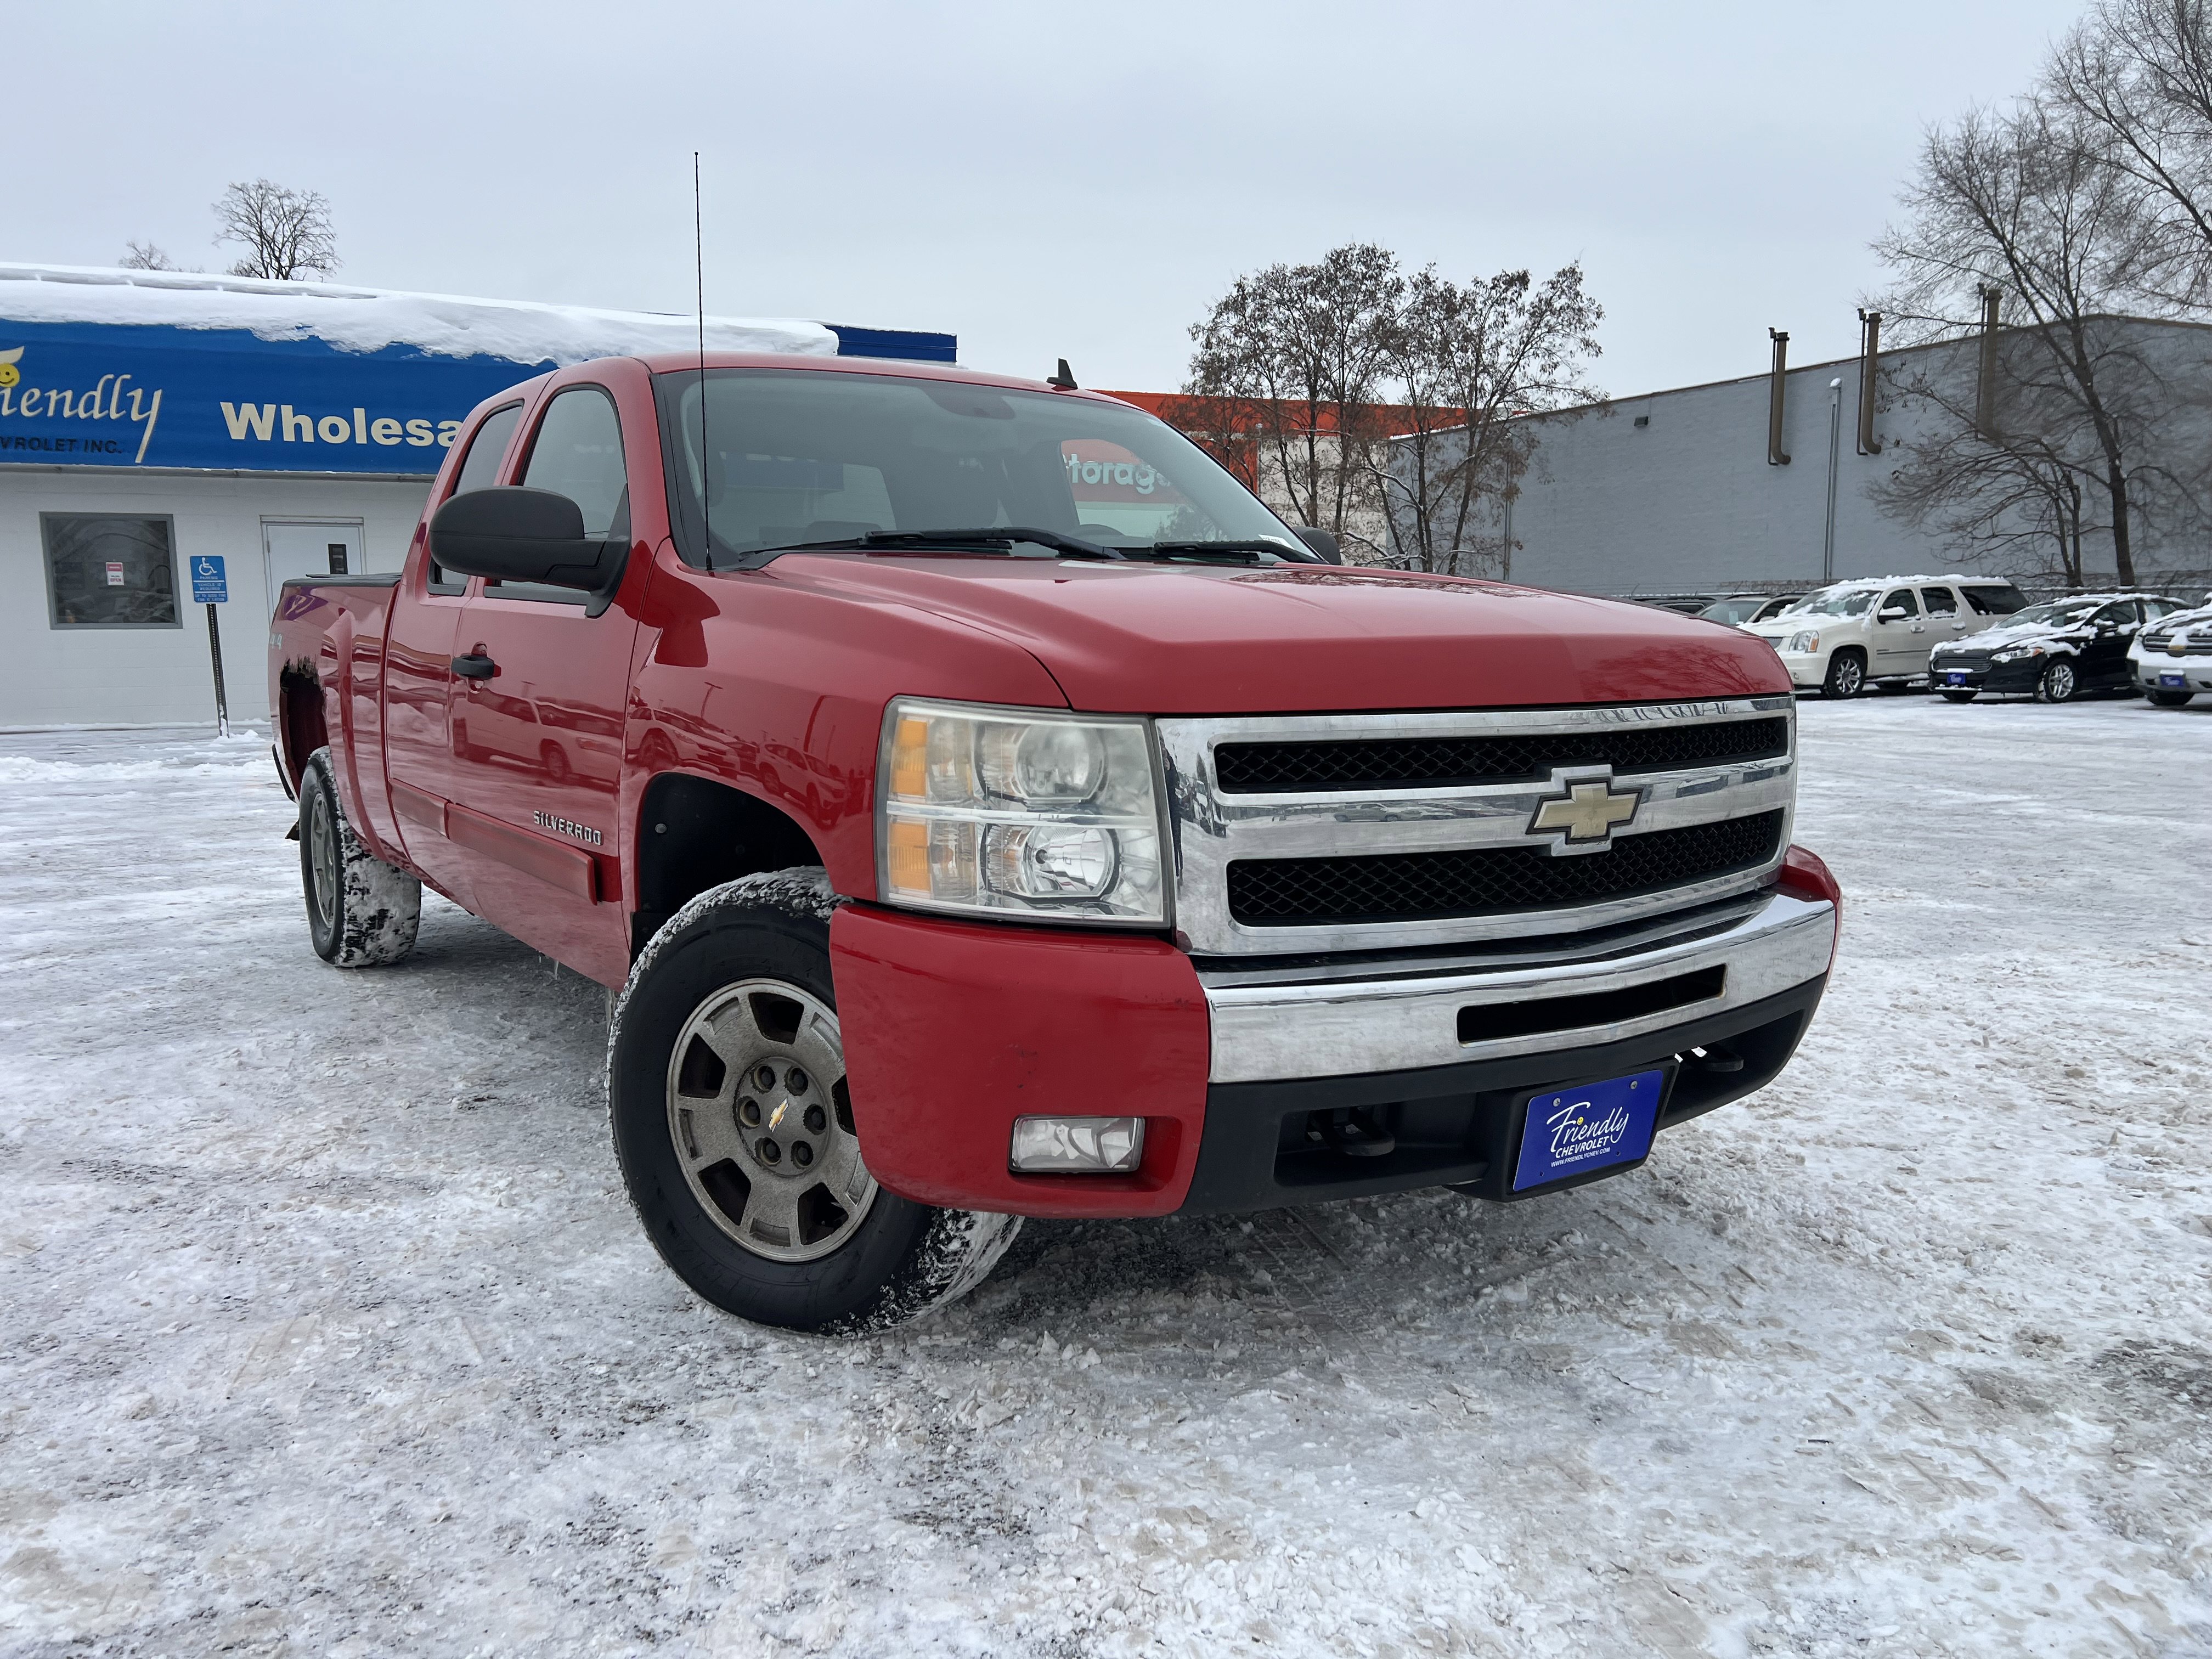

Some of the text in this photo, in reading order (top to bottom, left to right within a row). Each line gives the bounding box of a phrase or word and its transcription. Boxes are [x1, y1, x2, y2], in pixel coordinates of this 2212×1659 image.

[0, 346, 162, 463] iendly
[219, 401, 464, 447] Wholesa
[84, 439, 122, 454] INC.
[533, 810, 603, 846] SILVERADO
[1546, 1102, 1629, 1153] Friendly
[1551, 1147, 1611, 1168] WWW.FRIENDLYCHEV.COM
[1555, 1136, 1610, 1159] CHEVROLET
